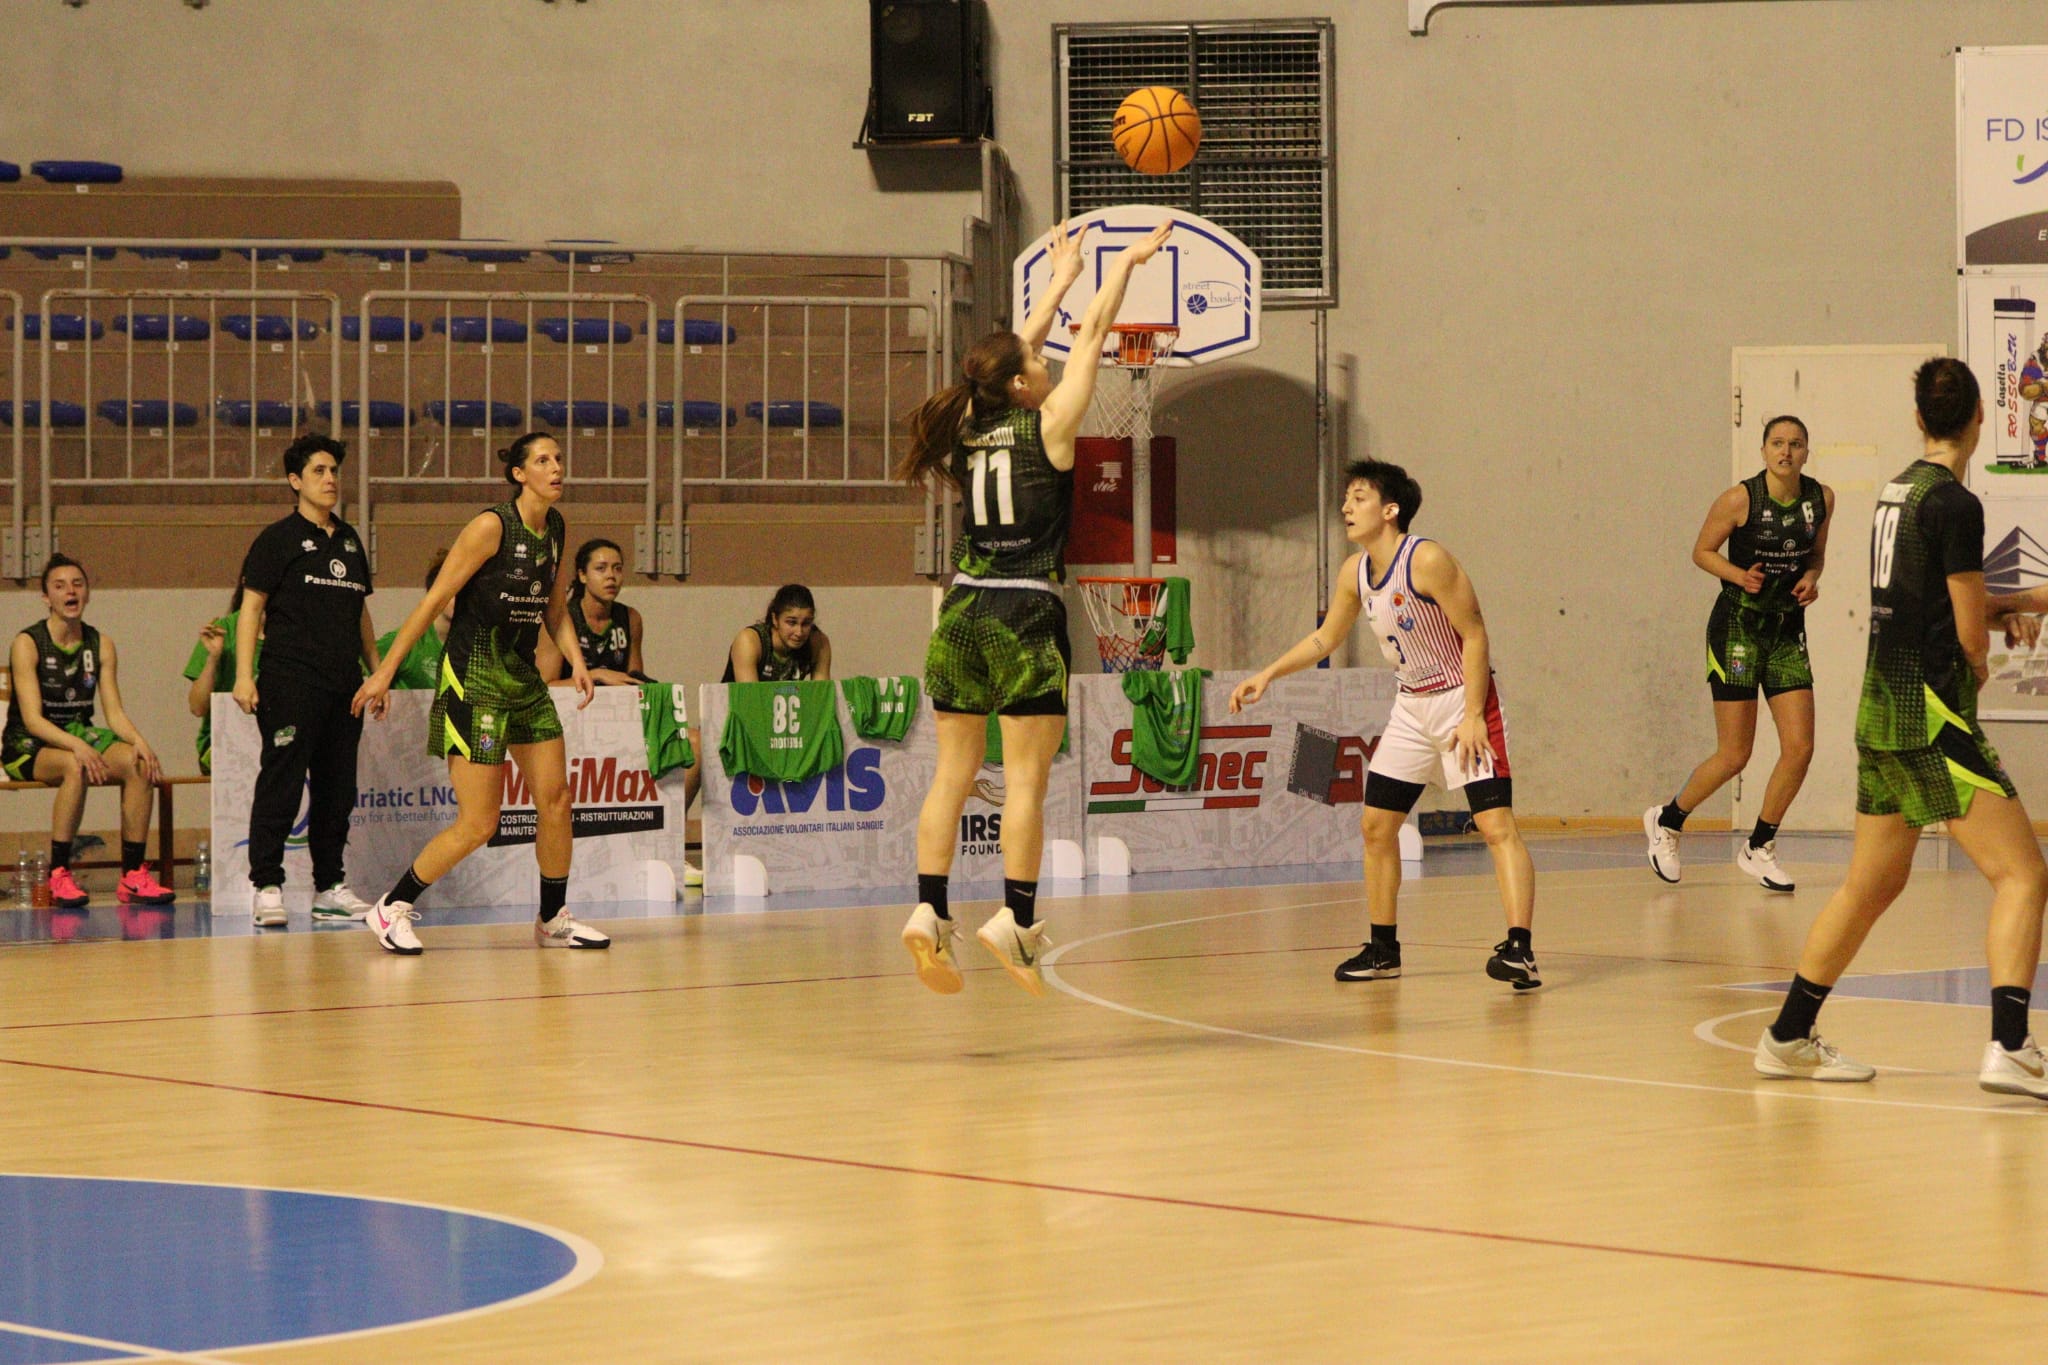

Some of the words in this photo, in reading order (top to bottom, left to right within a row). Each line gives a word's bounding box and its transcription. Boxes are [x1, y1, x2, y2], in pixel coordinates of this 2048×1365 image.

[1987, 118, 2025, 141] FD
[967, 449, 1015, 526] 11
[1802, 501, 1814, 523] 6
[1873, 505, 1901, 589] 18
[772, 695, 801, 734] 38
[500, 757, 659, 806] MiMax
[353, 787, 414, 807] riatic
[369, 812, 384, 822] for
[395, 810, 428, 822] better
[501, 814, 538, 824] COSTRUZ
[580, 811, 654, 822] RISTRUTTURAZIONI
[501, 826, 538, 837] MANUTEN
[733, 824, 785, 837] ASSOCIAZIONE
[785, 823, 825, 834] VOLONTARI
[825, 822, 855, 833] ITALIANI
[855, 820, 884, 831] SANGUE
[961, 813, 1002, 842] IRS
[961, 843, 1002, 856] FOUND
